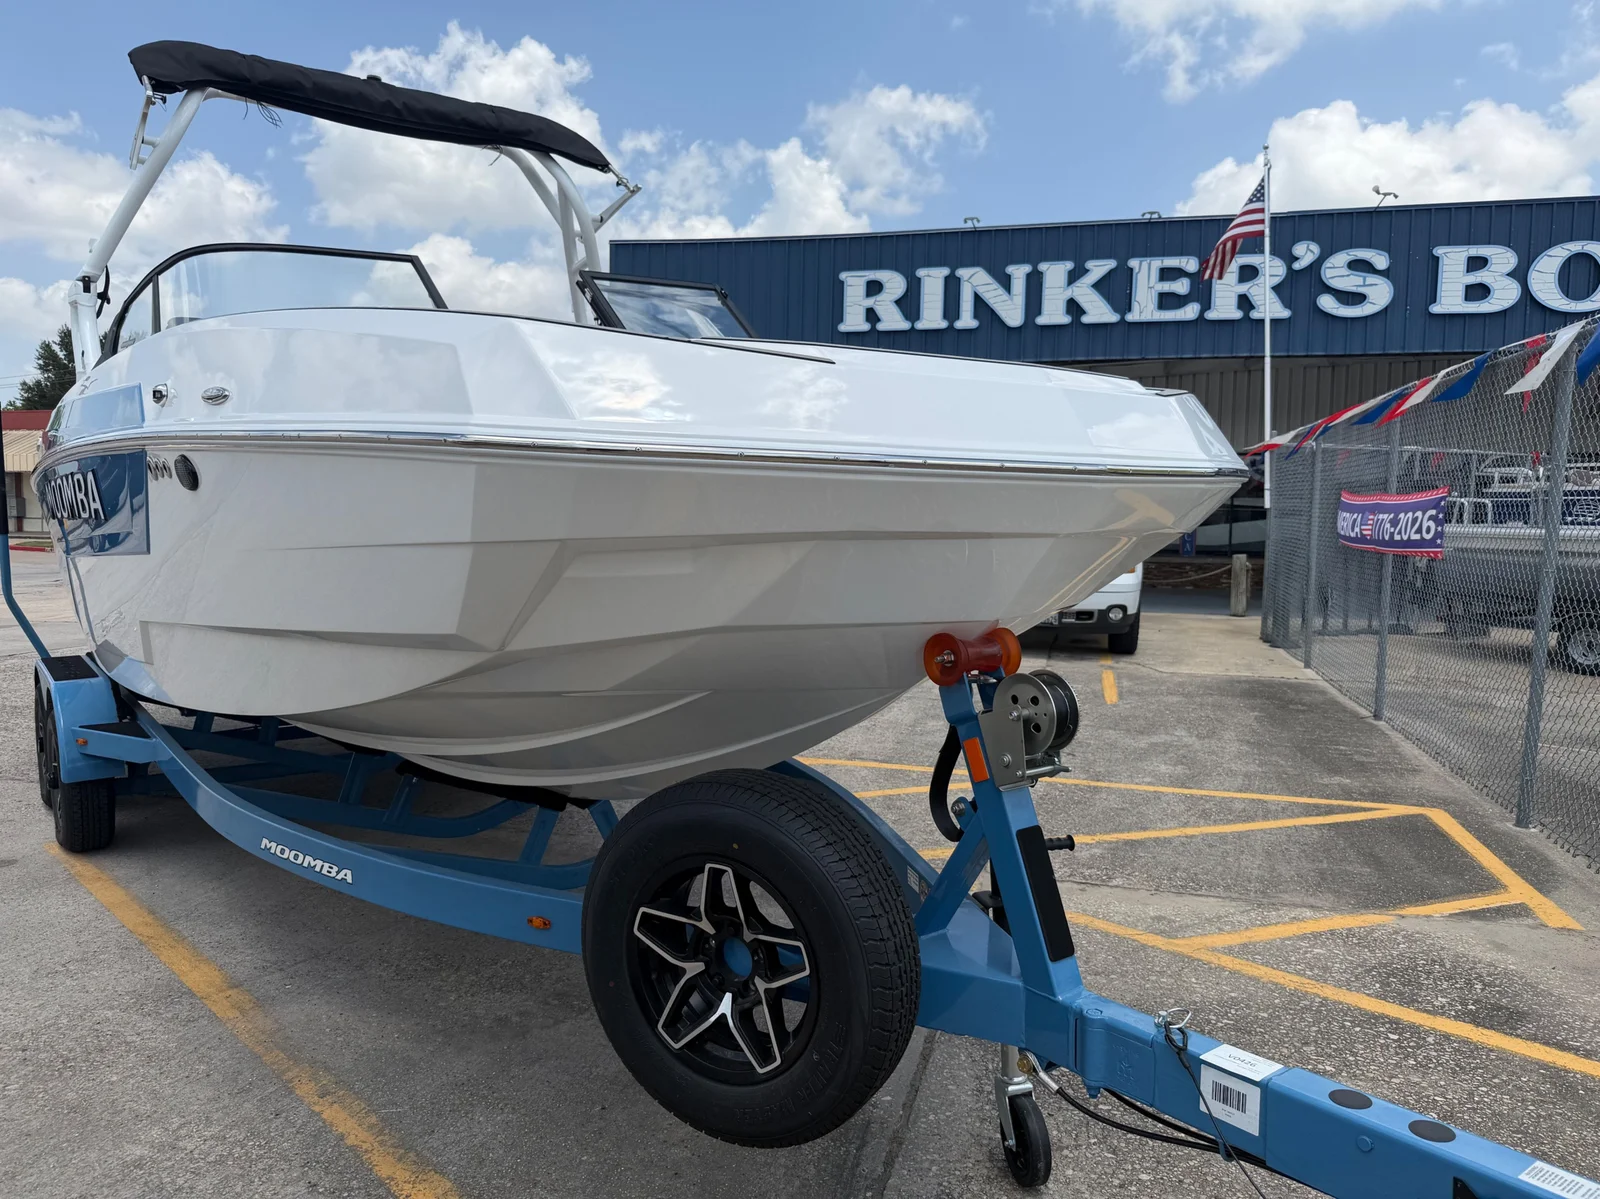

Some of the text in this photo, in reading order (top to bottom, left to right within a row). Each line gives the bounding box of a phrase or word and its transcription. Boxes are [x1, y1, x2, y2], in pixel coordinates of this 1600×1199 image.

[838, 240, 1600, 333] RINKER'S BO
[45, 470, 106, 520] MOOMBA
[259, 837, 354, 884] MOOMBA
